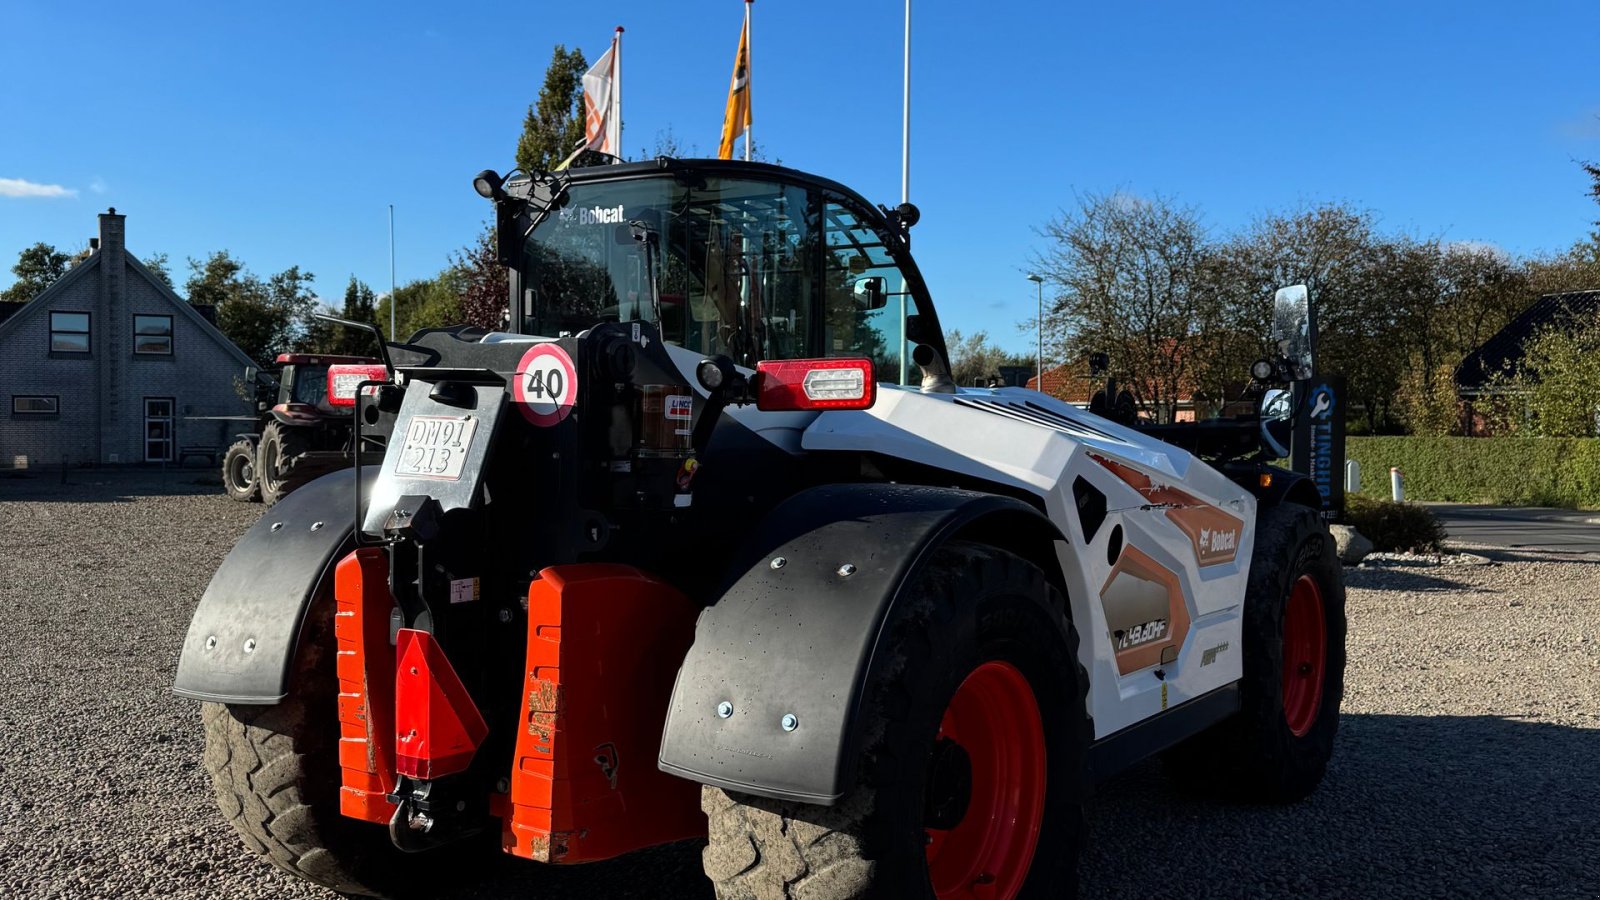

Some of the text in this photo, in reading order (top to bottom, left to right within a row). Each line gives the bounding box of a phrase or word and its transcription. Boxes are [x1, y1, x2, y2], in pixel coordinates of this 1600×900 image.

[580, 205, 623, 225] Bobcat
[527, 368, 563, 399] 40
[412, 420, 465, 447] DM91
[412, 448, 451, 473] 213
[1211, 529, 1235, 551] Bobcat
